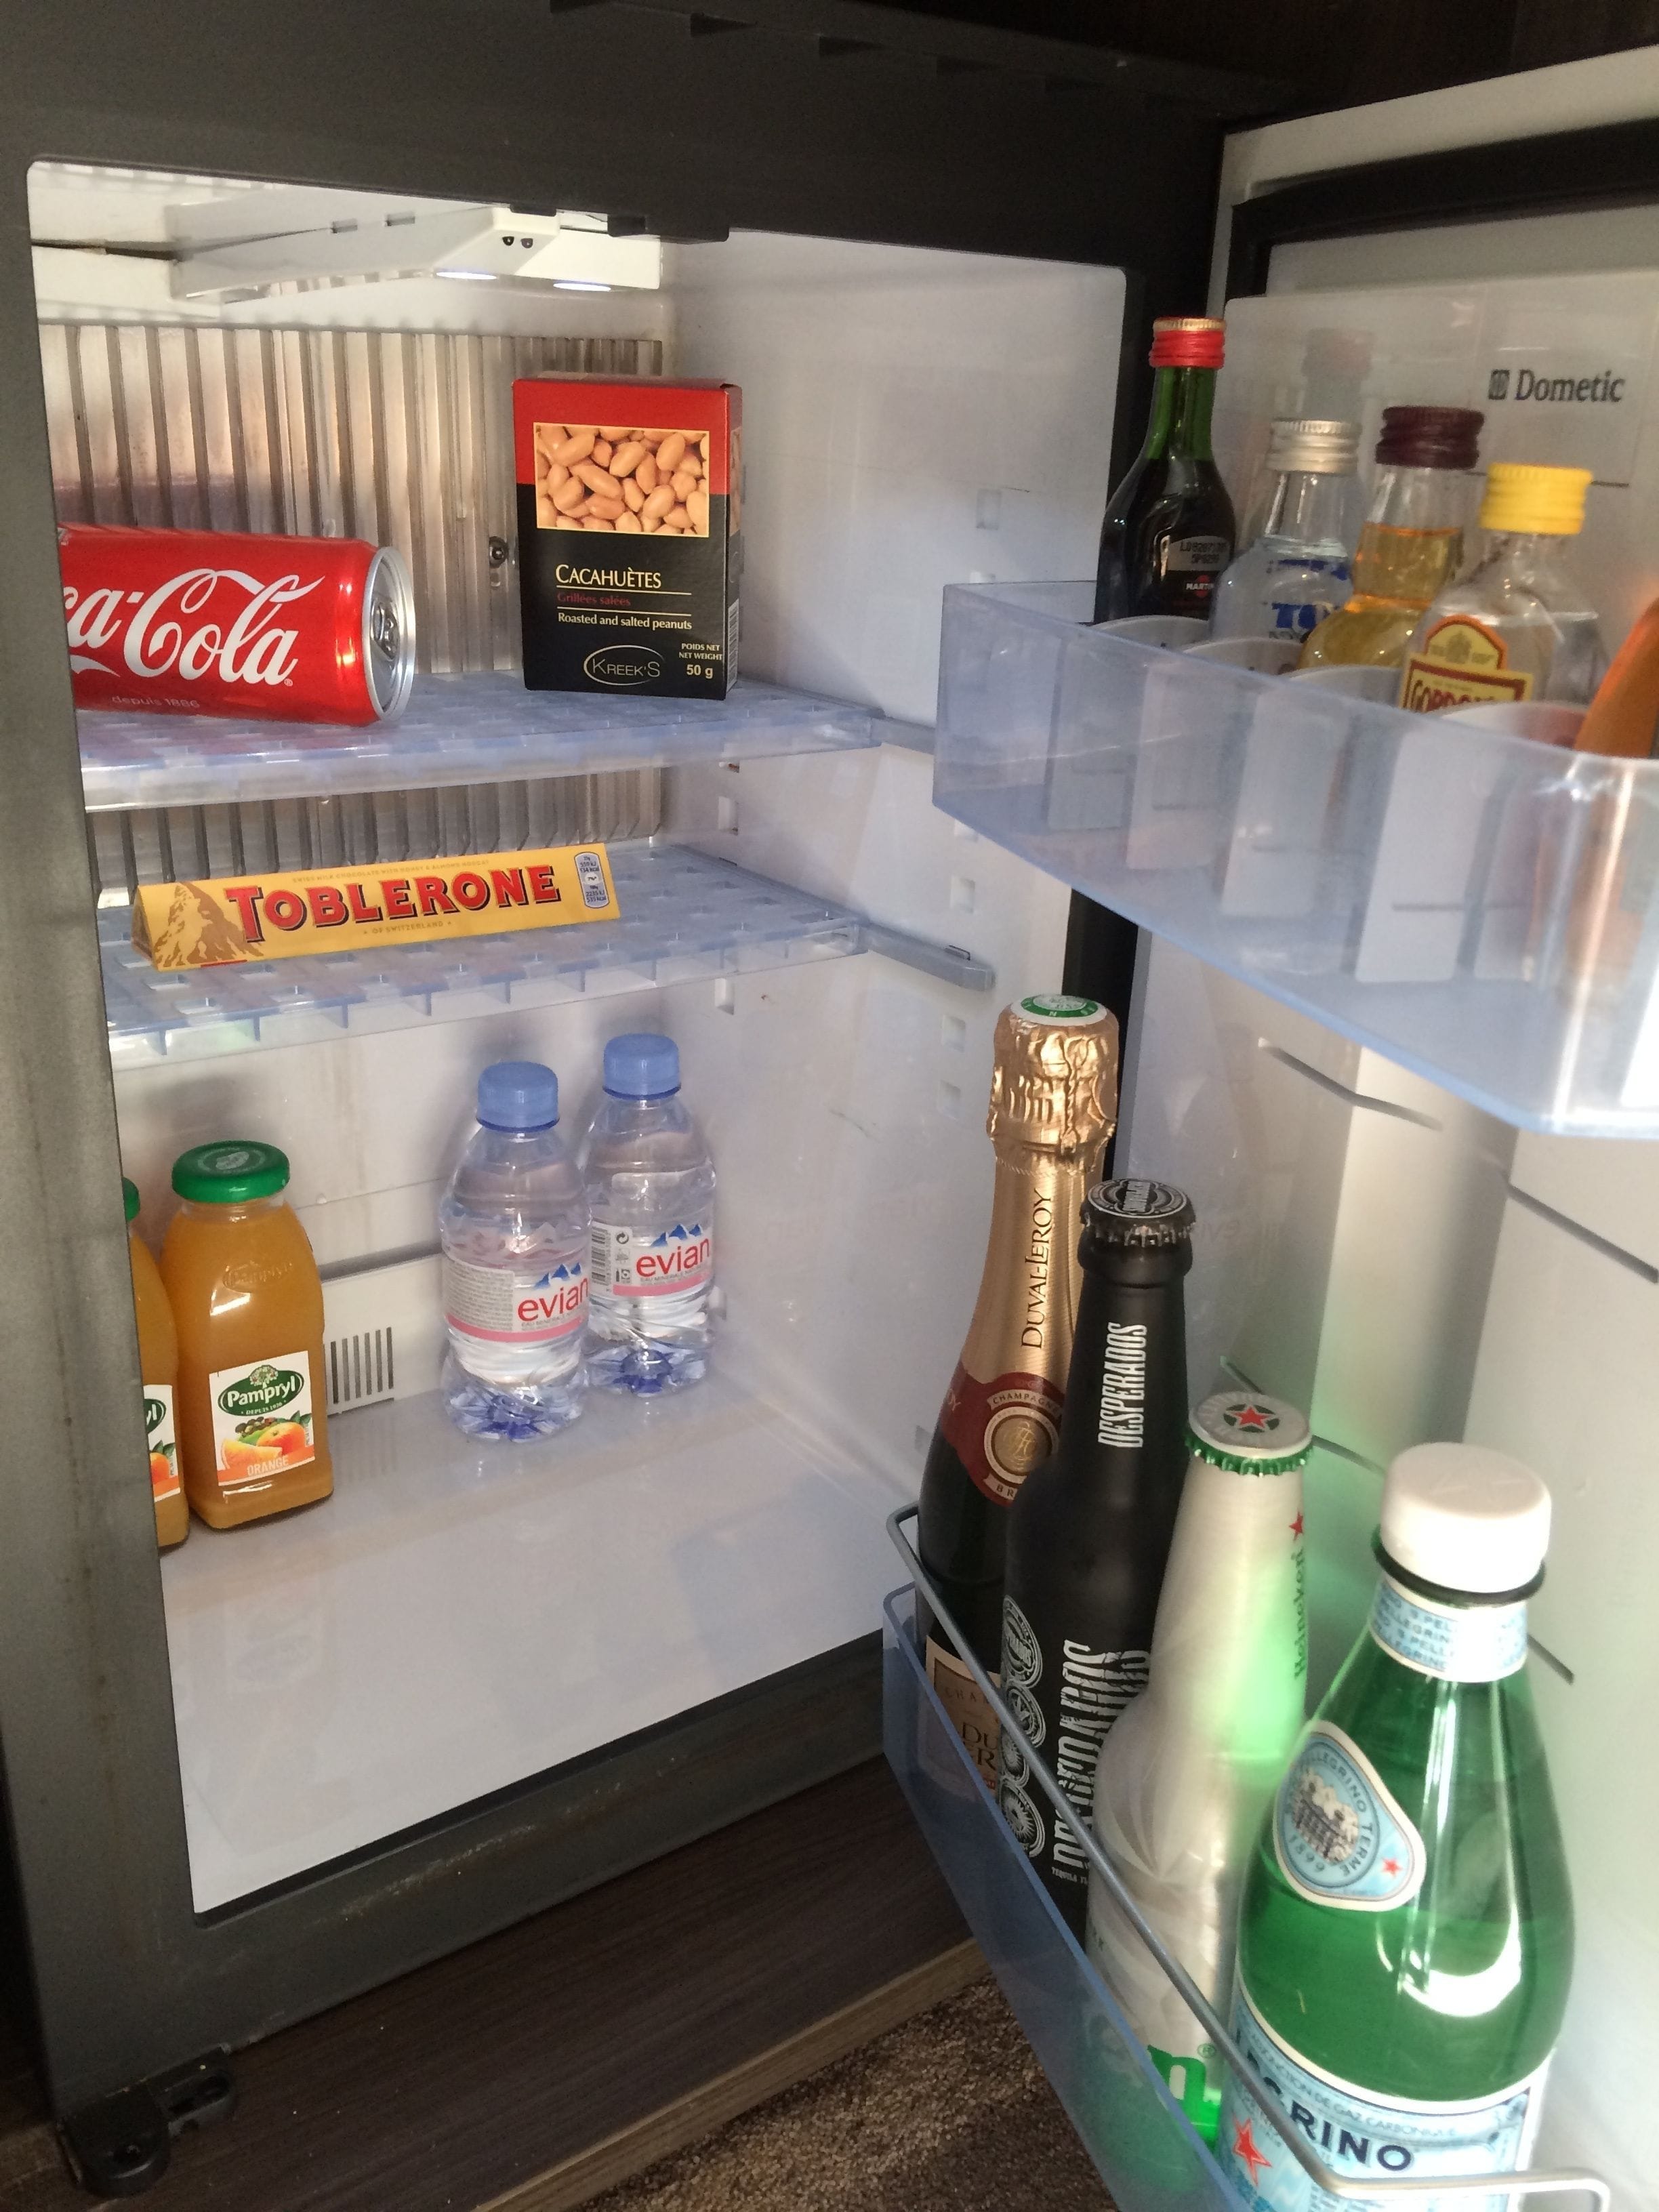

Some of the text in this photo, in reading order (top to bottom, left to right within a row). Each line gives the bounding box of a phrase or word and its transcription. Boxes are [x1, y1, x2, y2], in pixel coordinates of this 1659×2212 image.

[1515, 369, 1626, 403] Dometic
[556, 565, 661, 588] CACAHUÈTES
[557, 592, 631, 606] Grillées salées
[558, 613, 692, 630] Roasted and salted peanuts
[681, 643, 705, 651] POIDS
[694, 653, 723, 661] WEIGHT
[592, 658, 661, 678] KREEK'S
[687, 664, 714, 679] 50 g
[112, 696, 201, 709] depuis 1886
[335, 869, 379, 879] CHOCOLATE
[224, 864, 562, 943] TOBLERONE
[385, 921, 444, 933] SWITZERLAND
[636, 1237, 710, 1278] evian
[1022, 1187, 1052, 1350] DUVAL-LEROY
[518, 1275, 589, 1322] evian
[228, 1376, 296, 1408] Pampryl
[1097, 1322, 1148, 1449] DESPERADOS
[247, 1456, 289, 1477] ORANGE
[1339, 1822, 1373, 1877] TERME
